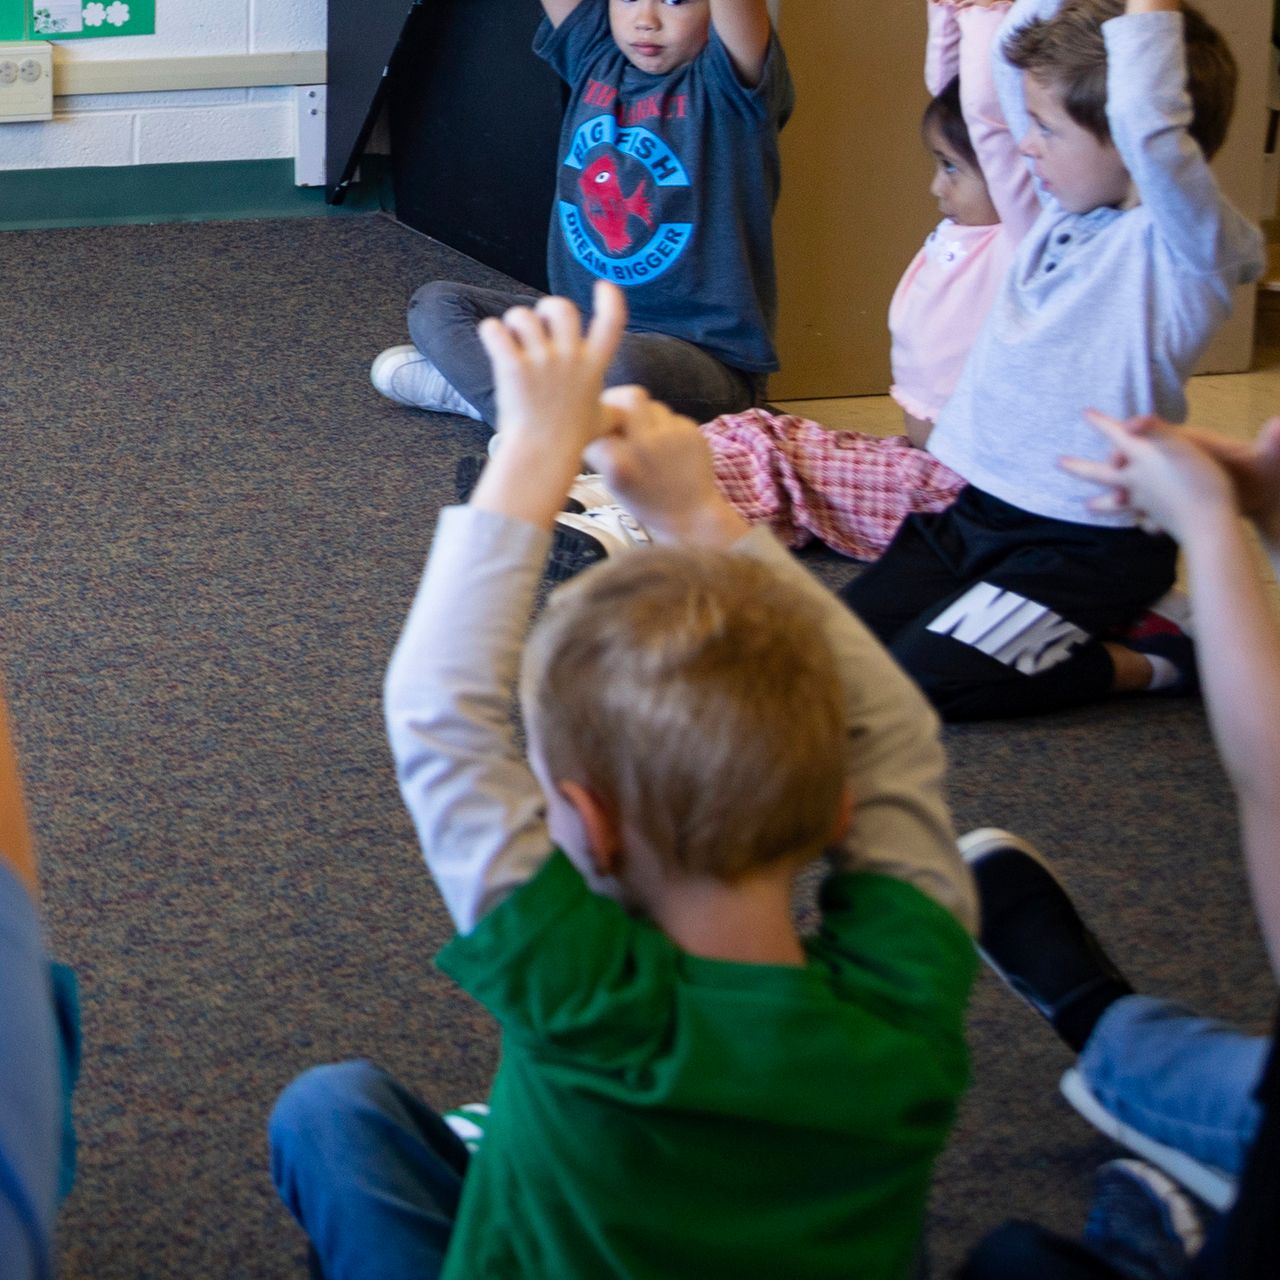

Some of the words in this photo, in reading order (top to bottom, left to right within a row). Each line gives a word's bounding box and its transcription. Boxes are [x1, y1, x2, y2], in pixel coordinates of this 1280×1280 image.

[614, 131, 676, 181] FISH
[566, 212, 609, 276] DREAM
[612, 227, 683, 280] BIGGER
[925, 580, 1091, 676] NIKE
